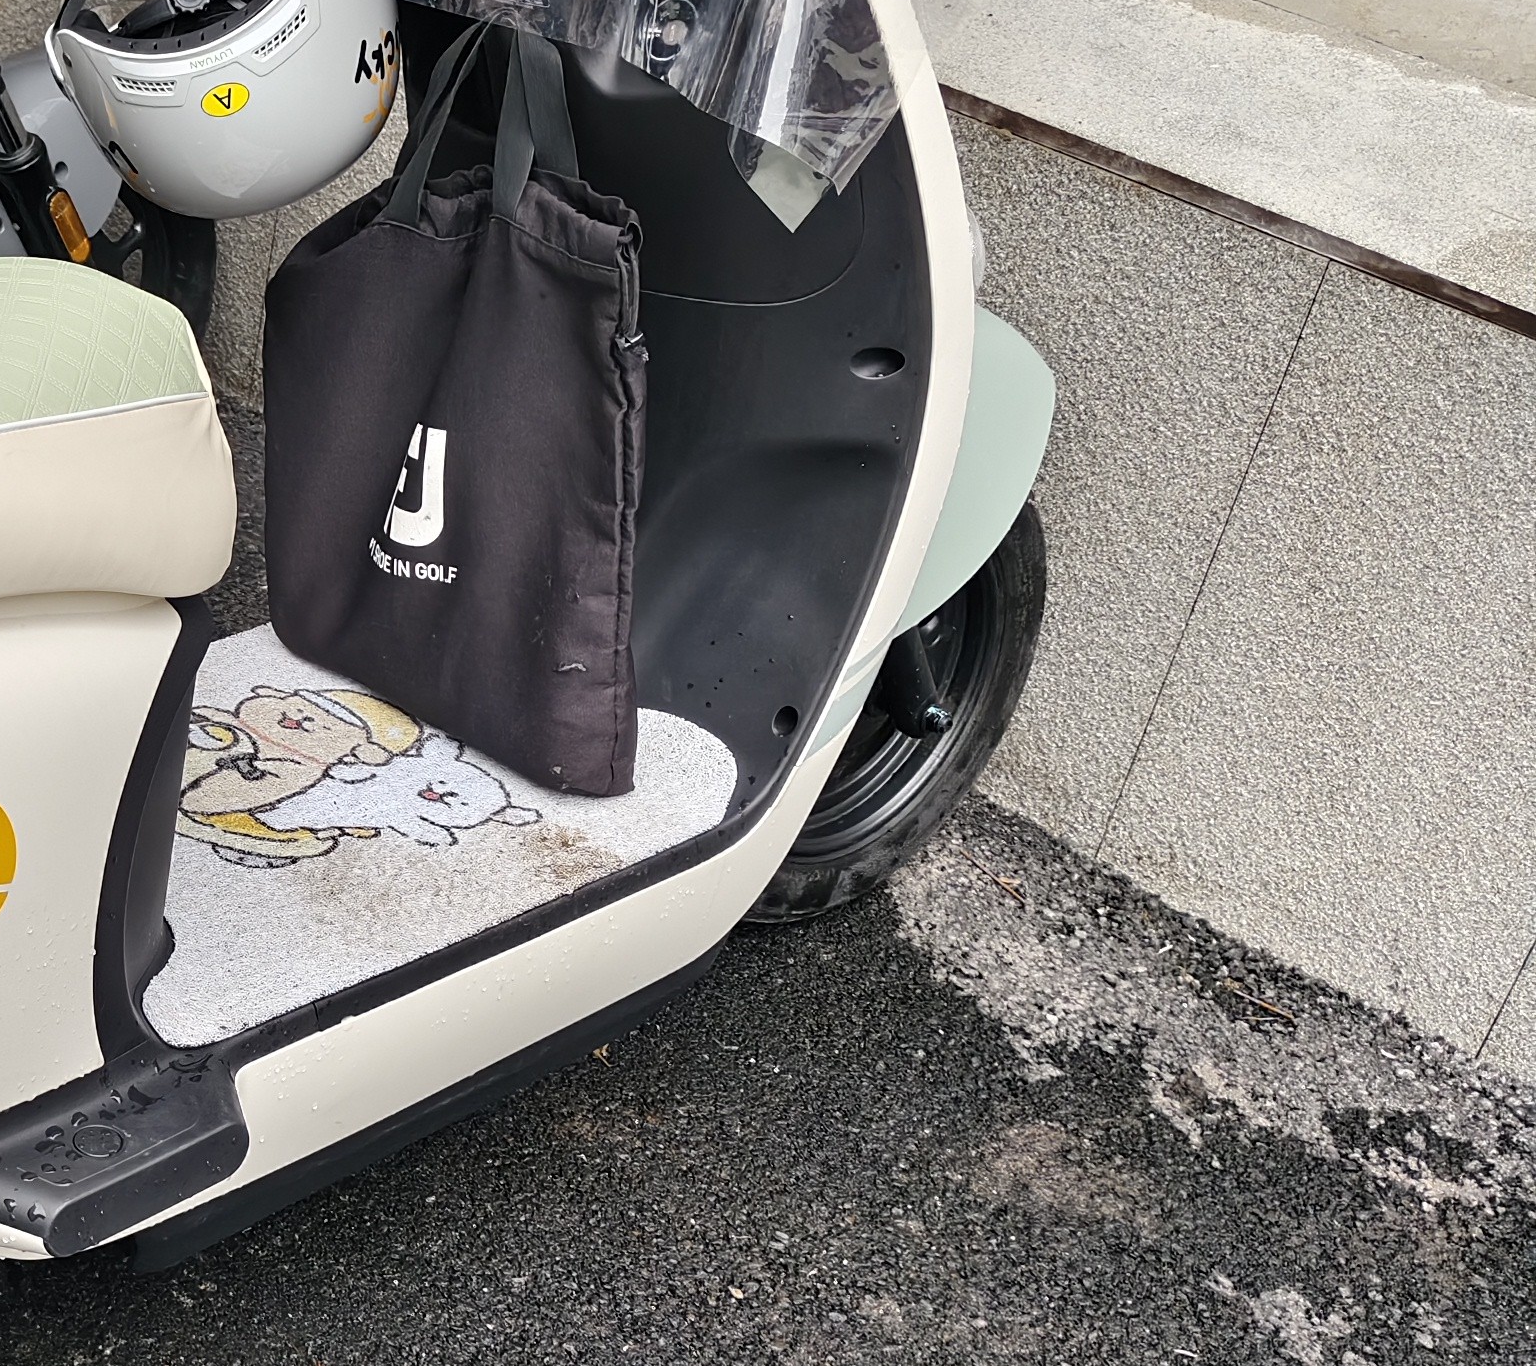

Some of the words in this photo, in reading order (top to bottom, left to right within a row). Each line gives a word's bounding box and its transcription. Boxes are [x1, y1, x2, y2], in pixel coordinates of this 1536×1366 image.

[189, 48, 234, 69] LUYUAN
[212, 87, 232, 110] A
[393, 558, 411, 578] IN
[414, 562, 458, 584] GOLF
